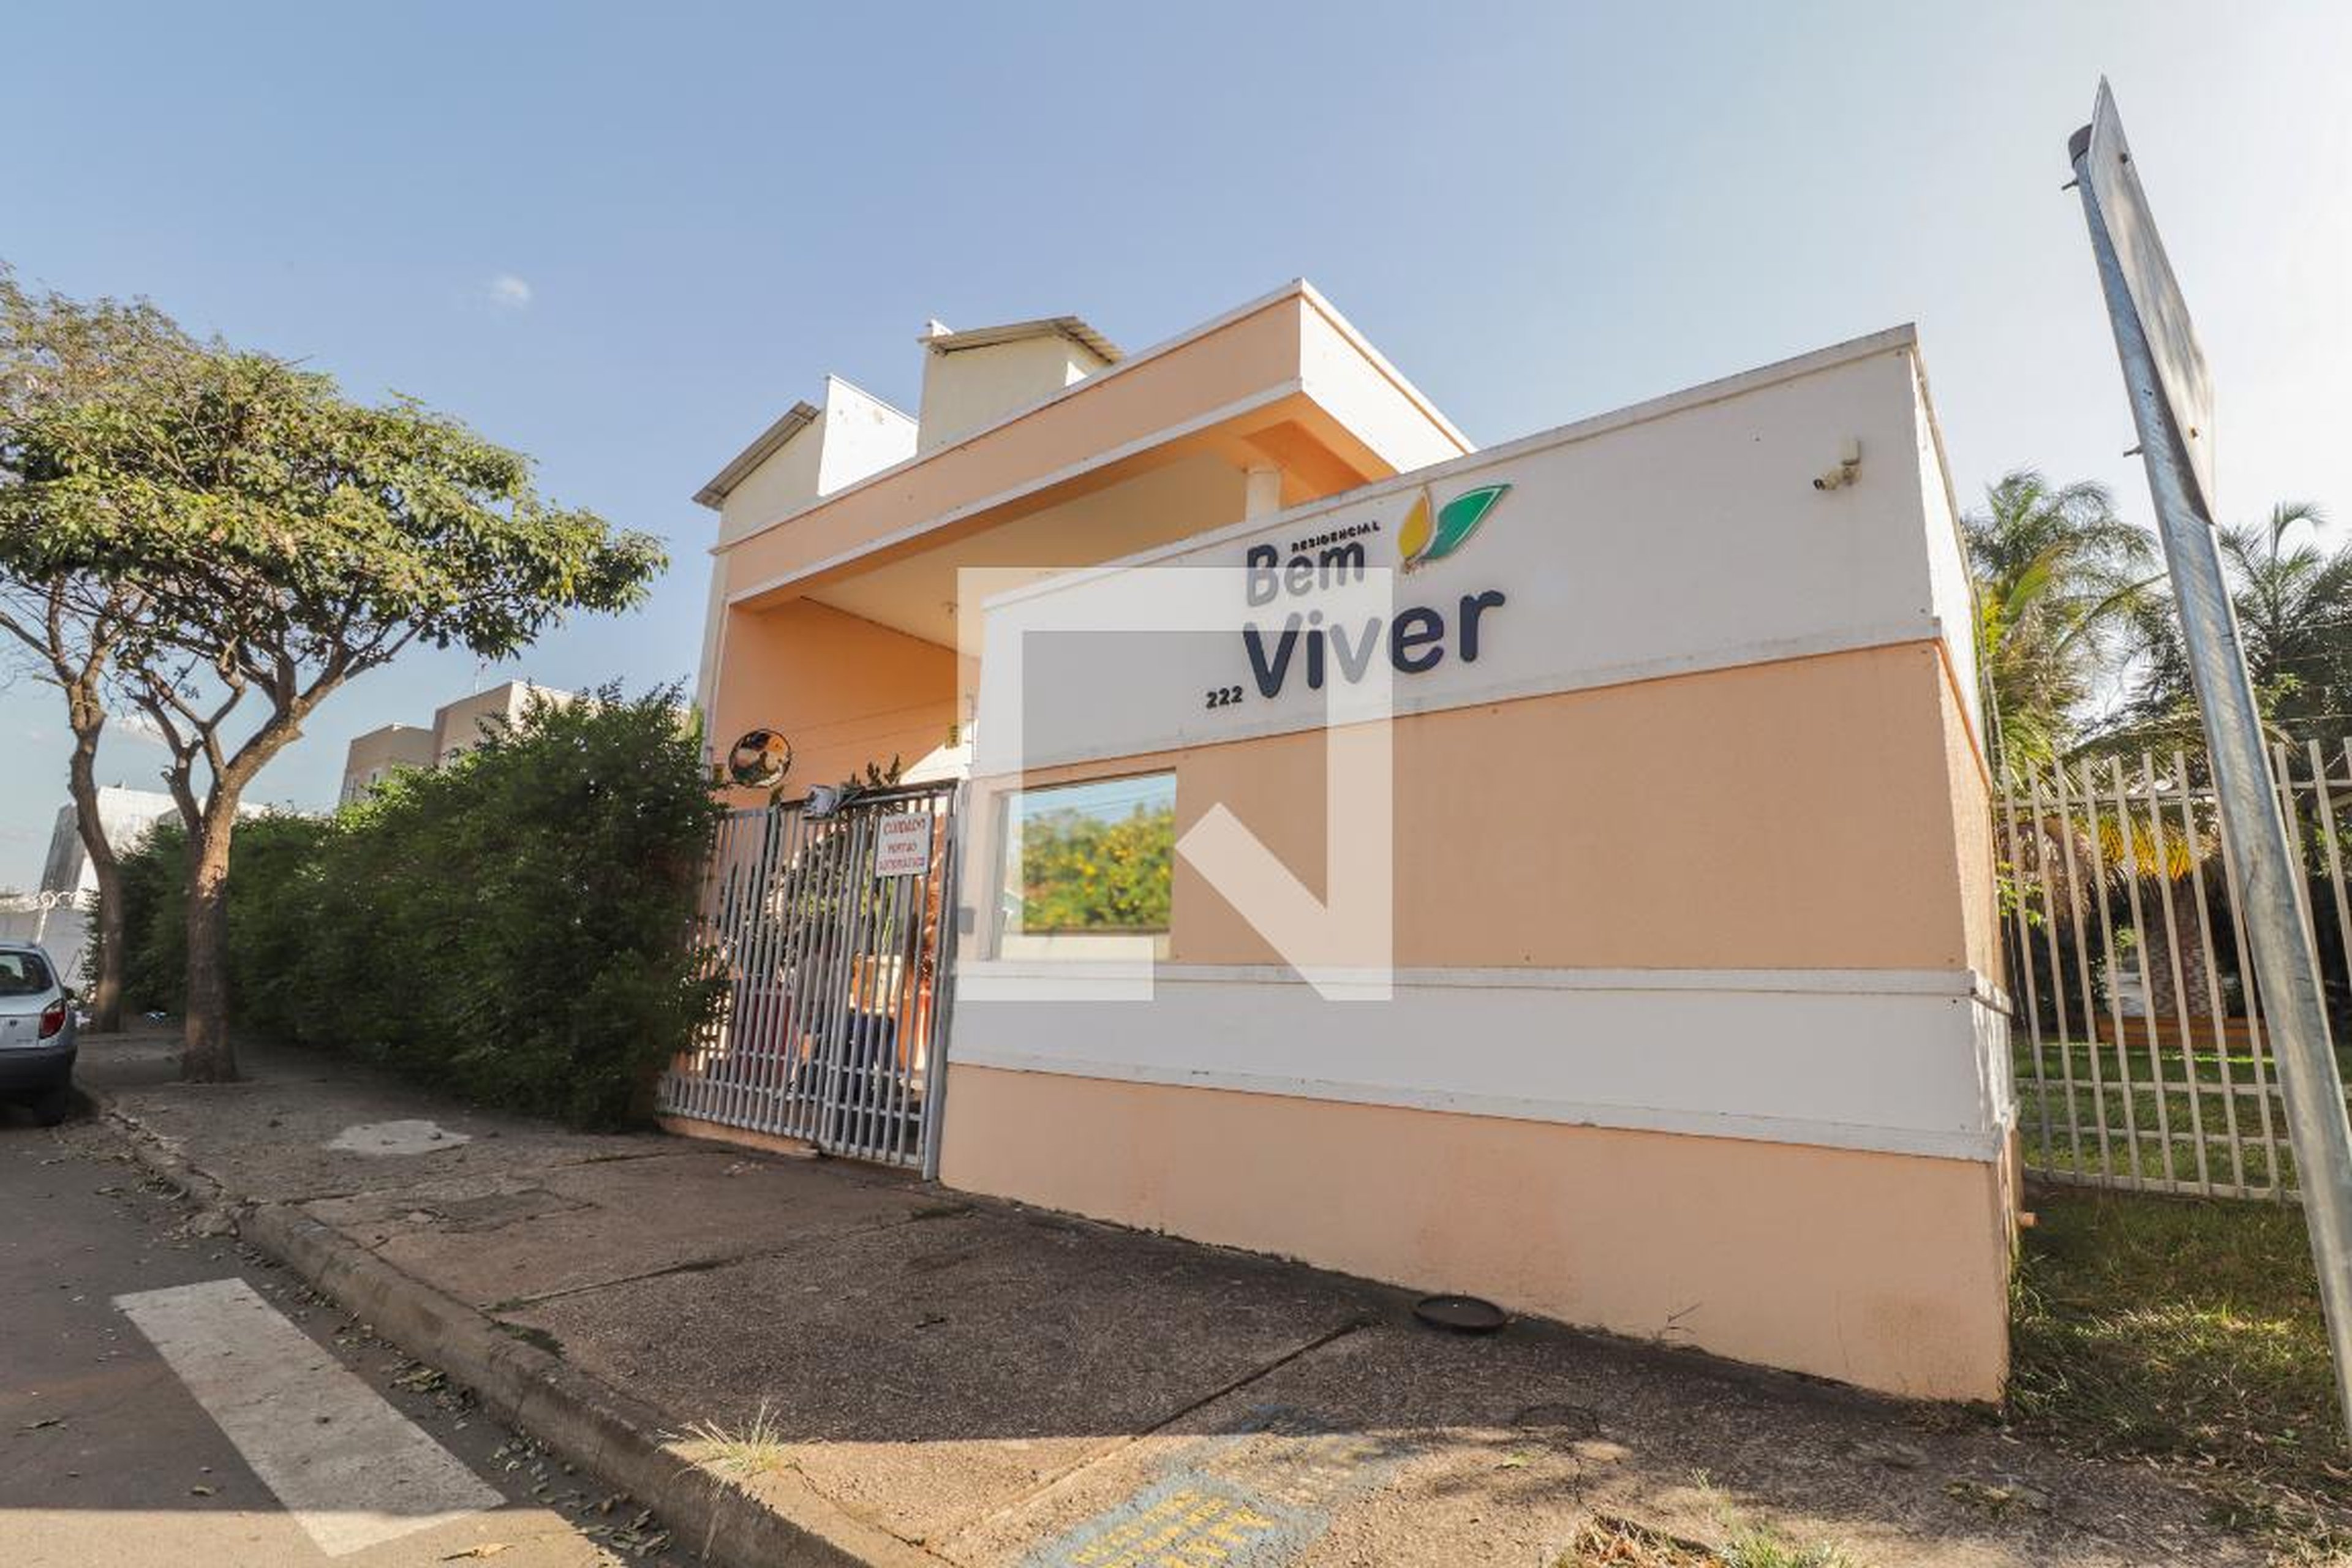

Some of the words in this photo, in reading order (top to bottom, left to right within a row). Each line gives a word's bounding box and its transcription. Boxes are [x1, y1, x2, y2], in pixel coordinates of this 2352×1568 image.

[1292, 521, 1380, 552] RESIDENCIAL
[1247, 541, 1365, 607] Bem
[1243, 590, 1506, 699] Viver
[1206, 686, 1244, 709] 222
